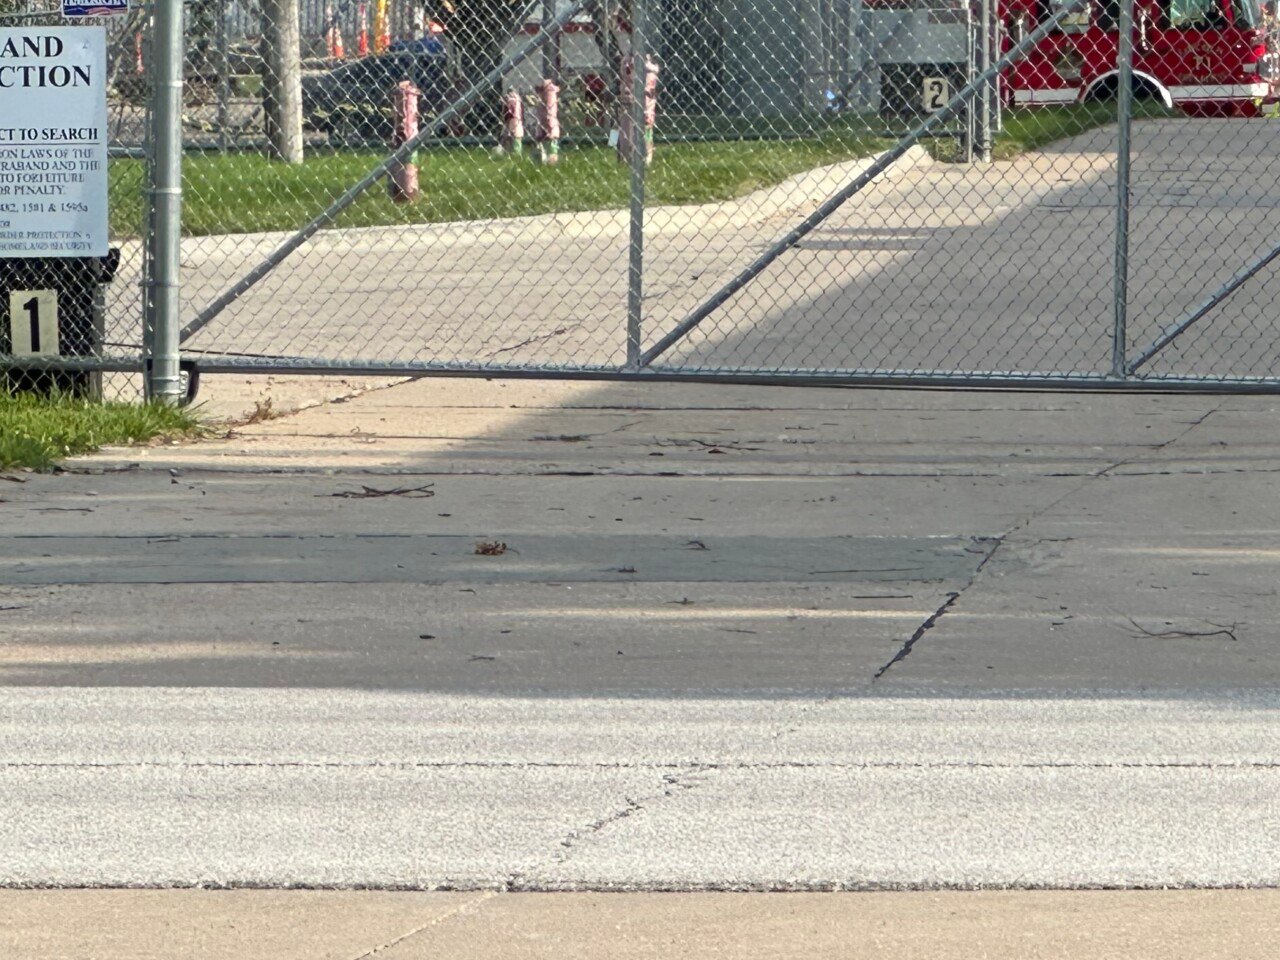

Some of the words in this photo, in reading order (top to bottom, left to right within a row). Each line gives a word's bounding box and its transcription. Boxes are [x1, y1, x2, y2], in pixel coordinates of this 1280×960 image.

[0, 35, 64, 58] AND
[0, 65, 92, 88] CTION
[929, 80, 944, 109] 2
[19, 128, 38, 141] TO
[42, 127, 98, 141] SEARCH
[21, 148, 52, 159] LAWS
[52, 161, 76, 171] AND
[23, 296, 40, 352] 1
